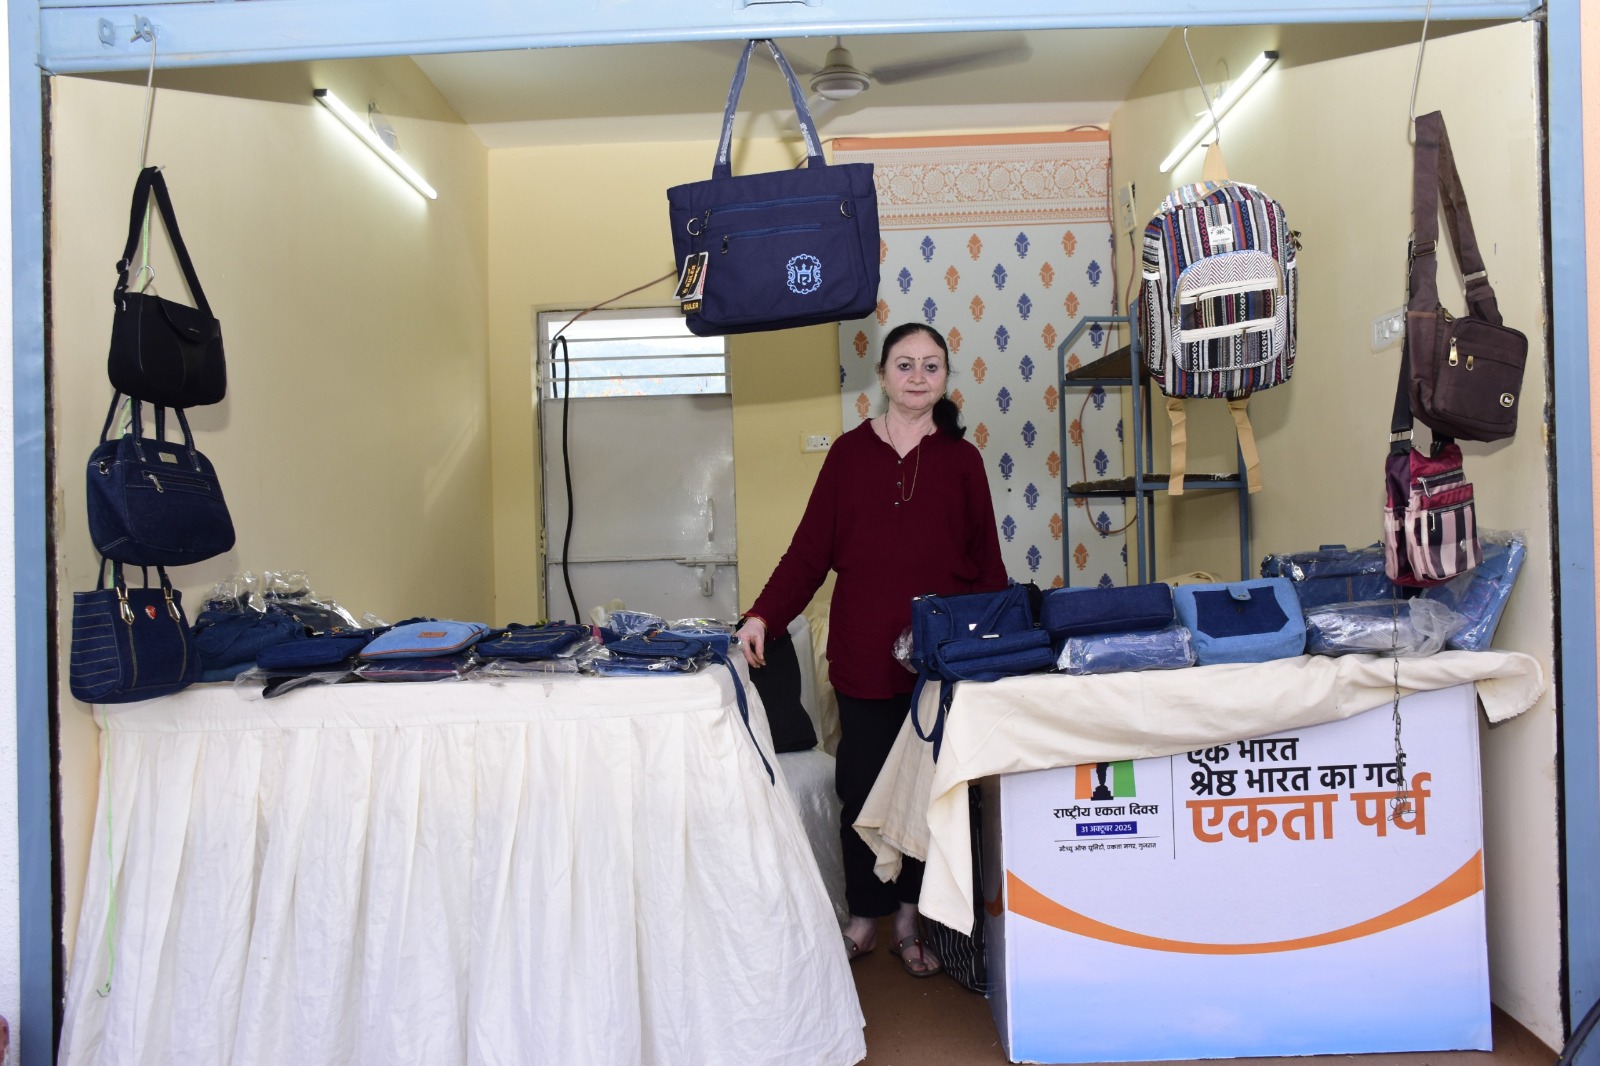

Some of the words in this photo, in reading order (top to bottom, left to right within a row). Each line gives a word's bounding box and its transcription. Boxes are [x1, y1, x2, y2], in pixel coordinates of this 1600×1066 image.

[684, 302, 698, 310] RULER
[1237, 738, 1299, 762] भारत
[1190, 762, 1238, 796] श्रेष्ठ
[1244, 766, 1311, 793] भारत
[1317, 764, 1357, 789] का
[1363, 753, 1406, 788] गर्व
[1053, 806, 1090, 820] राष्ट्रीय
[1094, 806, 1125, 817] एकता
[1129, 803, 1158, 814] दिवस
[1186, 794, 1338, 843] एकता
[1350, 772, 1431, 837] पर्व
[1090, 825, 1113, 835] अक्टूबर
[1114, 824, 1132, 832] 2025
